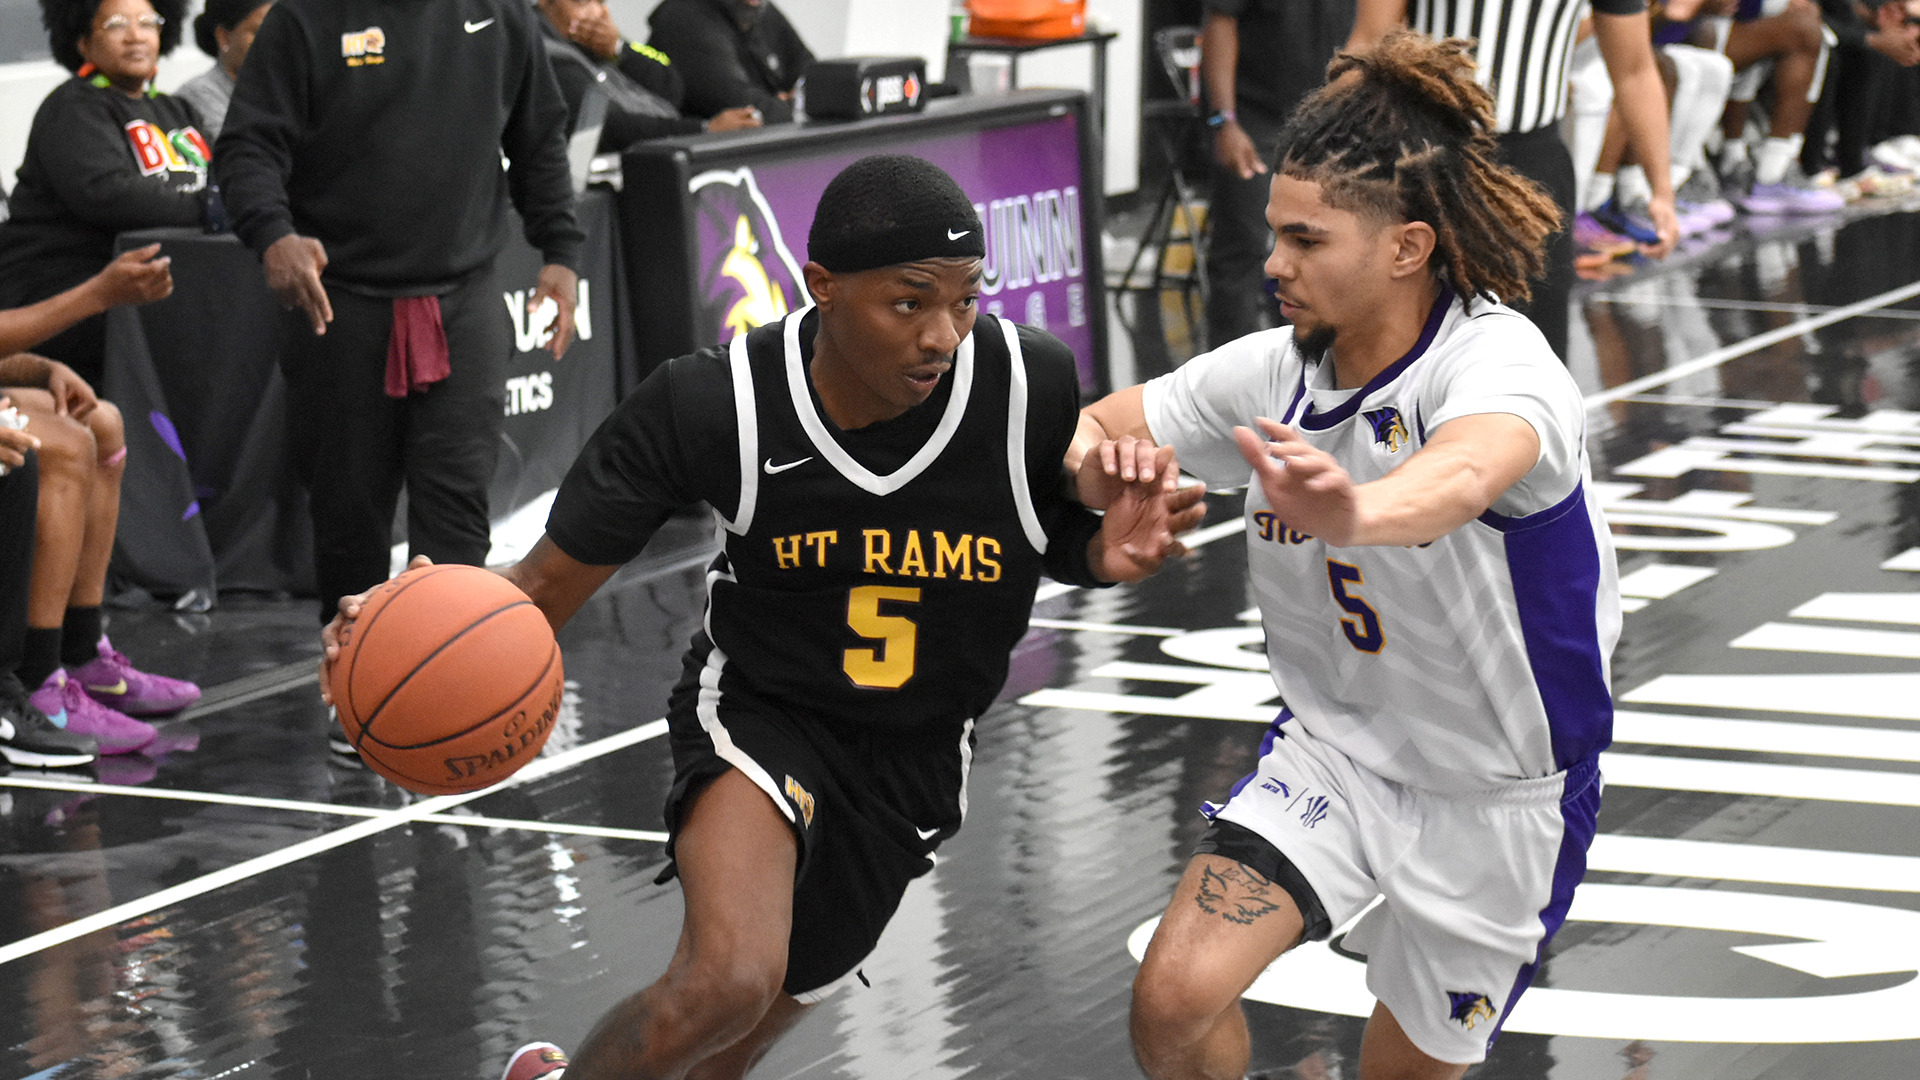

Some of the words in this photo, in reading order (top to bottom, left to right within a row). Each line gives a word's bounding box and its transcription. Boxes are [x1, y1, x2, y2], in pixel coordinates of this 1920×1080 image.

[973, 185, 1084, 296] UINN
[772, 528, 838, 570] HT
[861, 527, 1002, 583] RAMS
[1326, 557, 1386, 655] 5
[842, 584, 922, 690] 5
[444, 679, 562, 781] SPALDING
